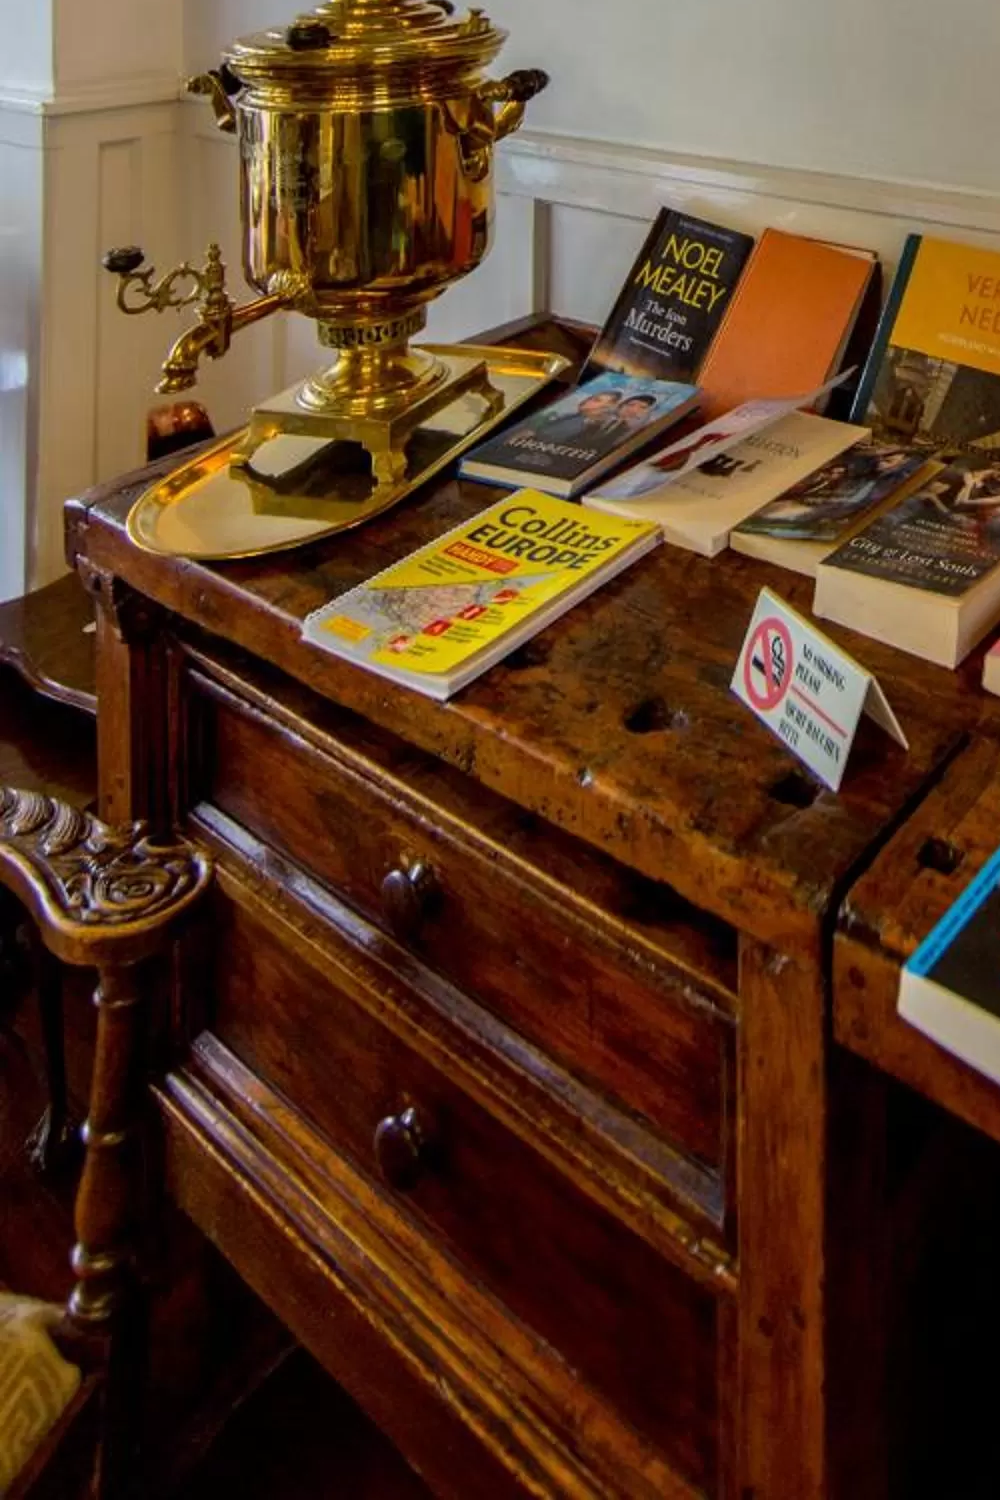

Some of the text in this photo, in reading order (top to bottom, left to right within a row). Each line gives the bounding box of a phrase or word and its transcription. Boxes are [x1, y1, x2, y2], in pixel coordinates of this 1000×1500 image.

[661, 233, 725, 278] NOEL
[634, 260, 727, 313] MEALEY
[623, 307, 694, 351] Murders
[466, 523, 598, 570] EUROPE
[499, 506, 621, 552] Collins
[850, 537, 883, 555] City
[899, 550, 935, 566] Lost
[936, 559, 978, 577] Souls
